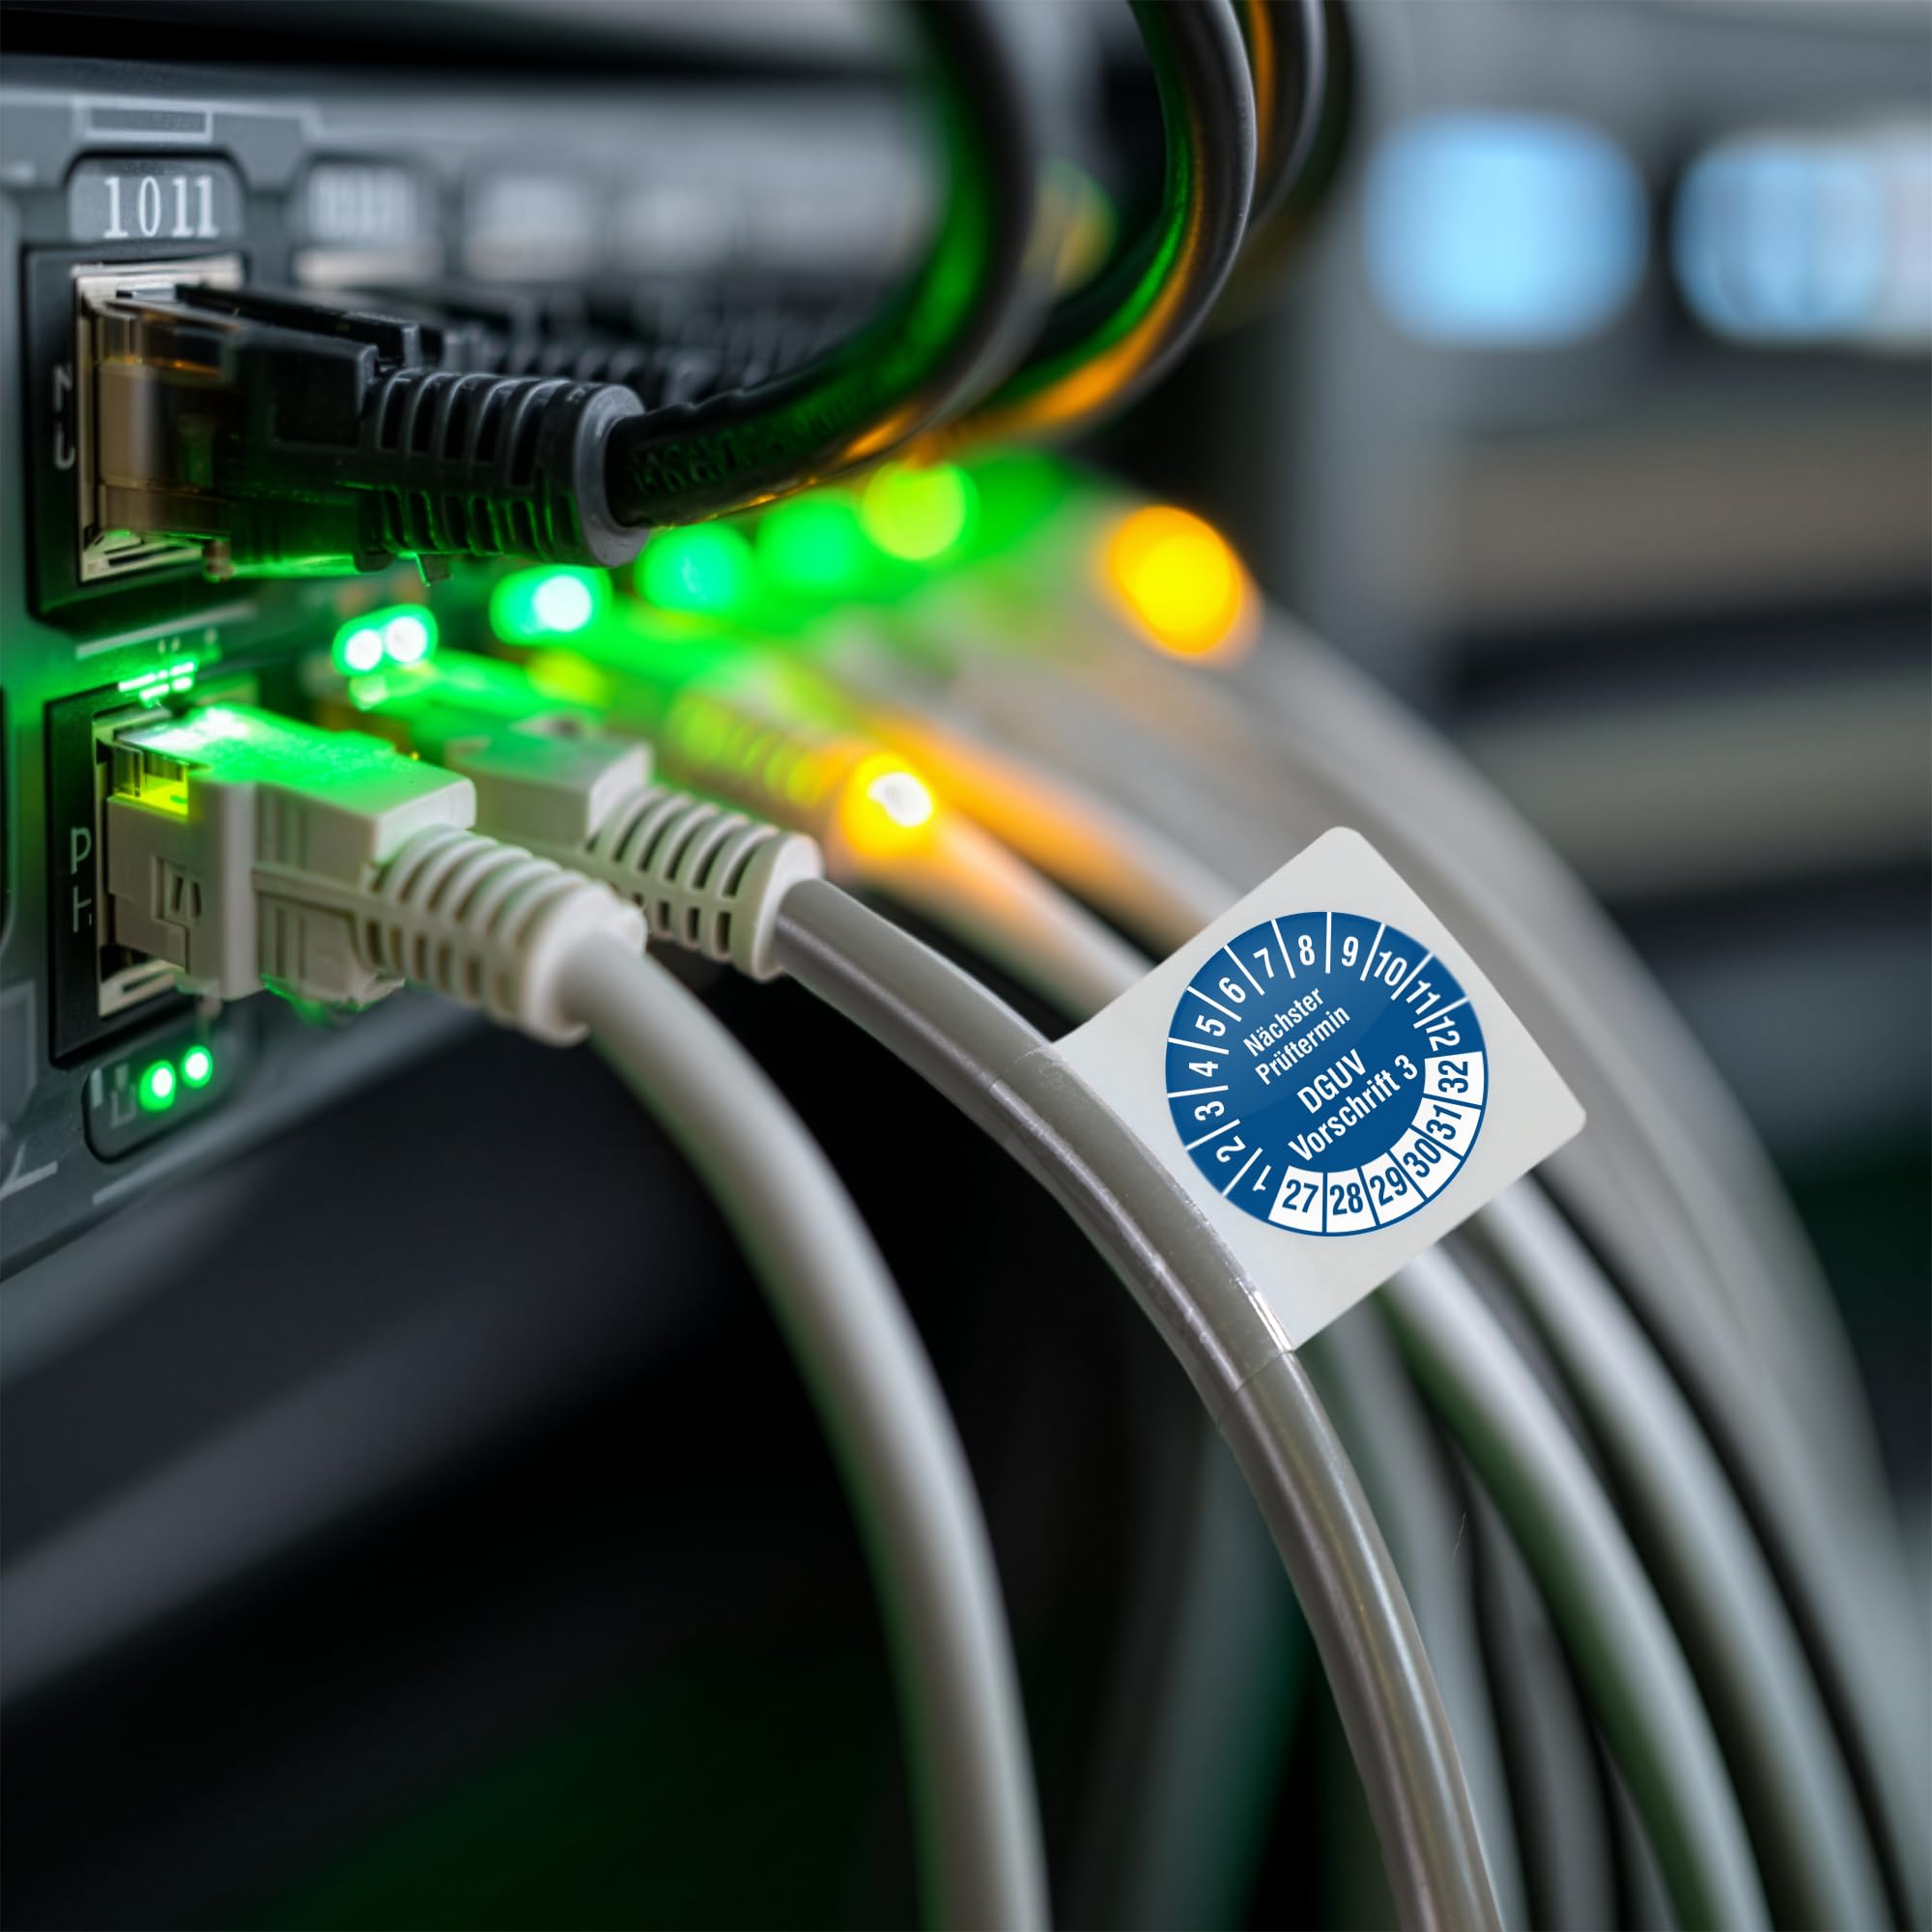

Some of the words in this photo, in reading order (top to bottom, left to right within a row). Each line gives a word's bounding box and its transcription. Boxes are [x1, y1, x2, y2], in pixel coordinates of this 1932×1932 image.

[103, 175, 220, 239] 1011
[1253, 948, 1275, 979] 7
[1297, 934, 1316, 966] 8
[1341, 936, 1359, 967] 9
[1374, 950, 1407, 987] 10
[1218, 977, 1247, 1004] 6
[1406, 979, 1441, 1015] 11
[1195, 1014, 1227, 1037] 5
[1242, 987, 1324, 1057] Nächster
[1426, 1015, 1461, 1052] 12
[1255, 1007, 1350, 1086] Prüftermin
[1188, 1061, 1219, 1078] 4
[1296, 1049, 1368, 1114] DGUV
[1438, 1060, 1469, 1094] 32
[1194, 1100, 1225, 1122] 3
[1288, 1070, 1402, 1161] Vorschrift
[1394, 1054, 1418, 1080] 3
[1426, 1103, 1463, 1141] 31
[1216, 1135, 1246, 1162] 2
[1403, 1136, 1442, 1179] 30
[1252, 1164, 1272, 1192] 1
[1370, 1165, 1409, 1207] 29
[1282, 1179, 1319, 1214] 27
[1329, 1181, 1364, 1216] 28
